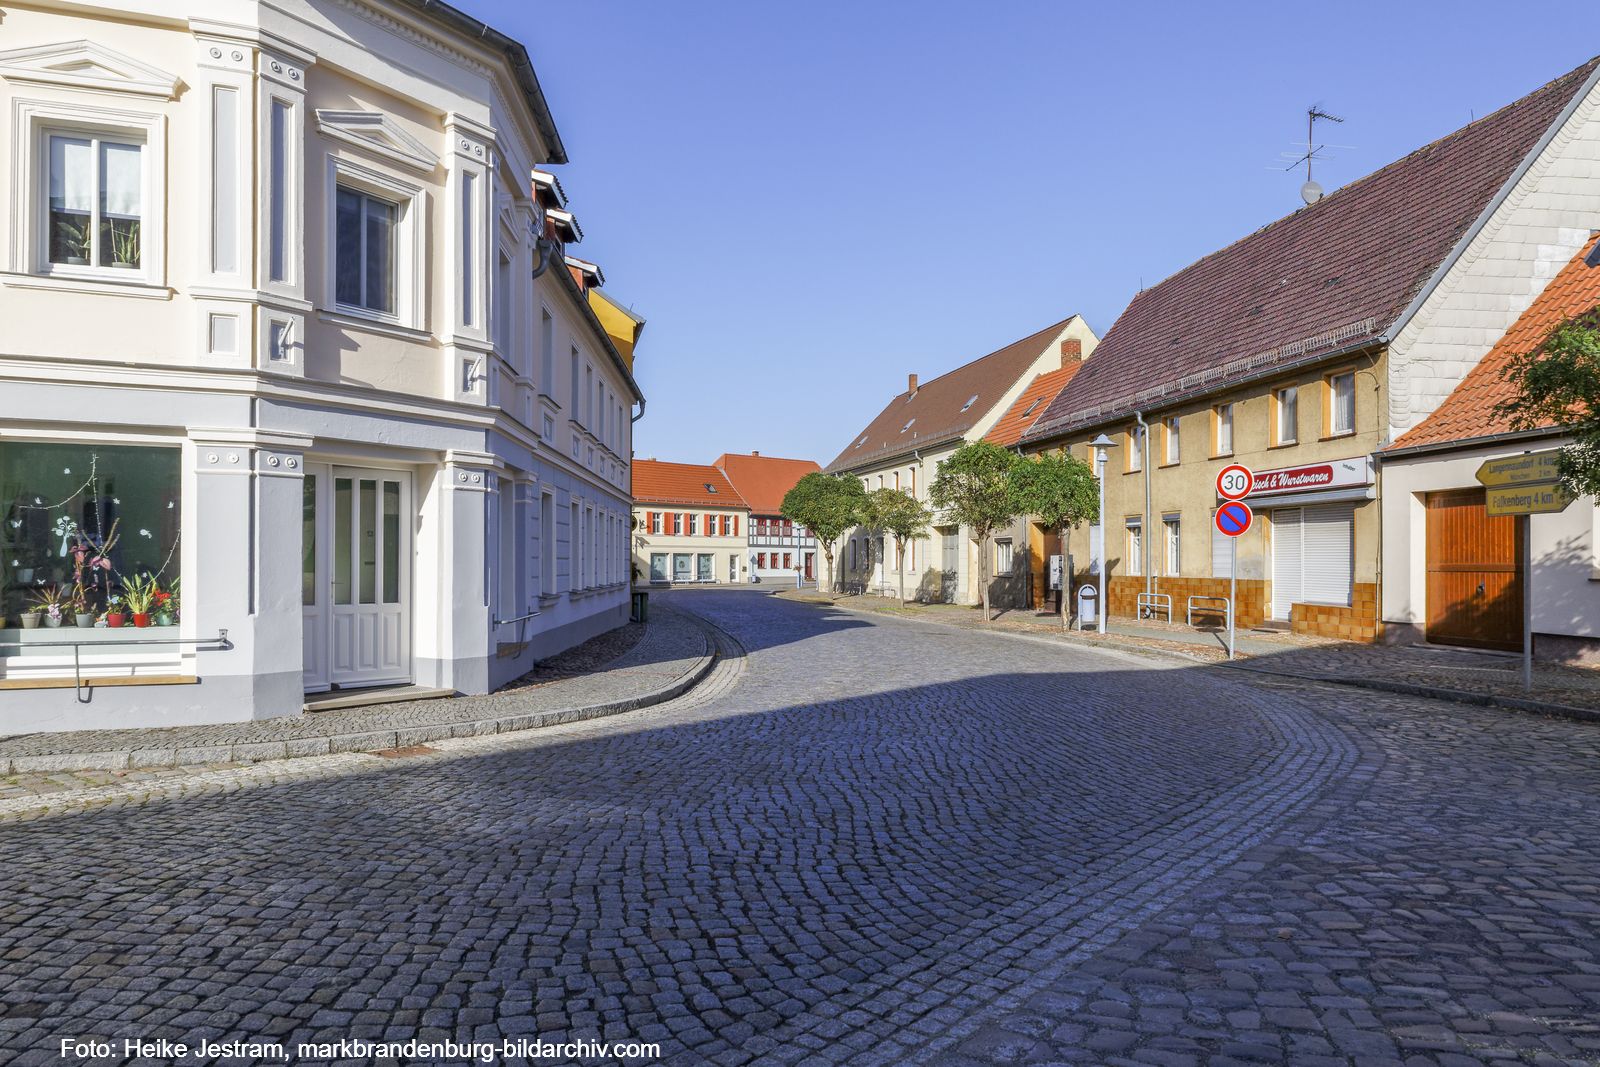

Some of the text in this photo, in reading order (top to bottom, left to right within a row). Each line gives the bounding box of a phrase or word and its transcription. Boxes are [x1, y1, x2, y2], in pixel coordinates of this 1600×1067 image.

[1224, 474, 1245, 490] 30
[1270, 474, 1277, 488] &
[1278, 473, 1329, 486] Wurstwaren
[1493, 492, 1554, 508] Falkenberg 4 km
